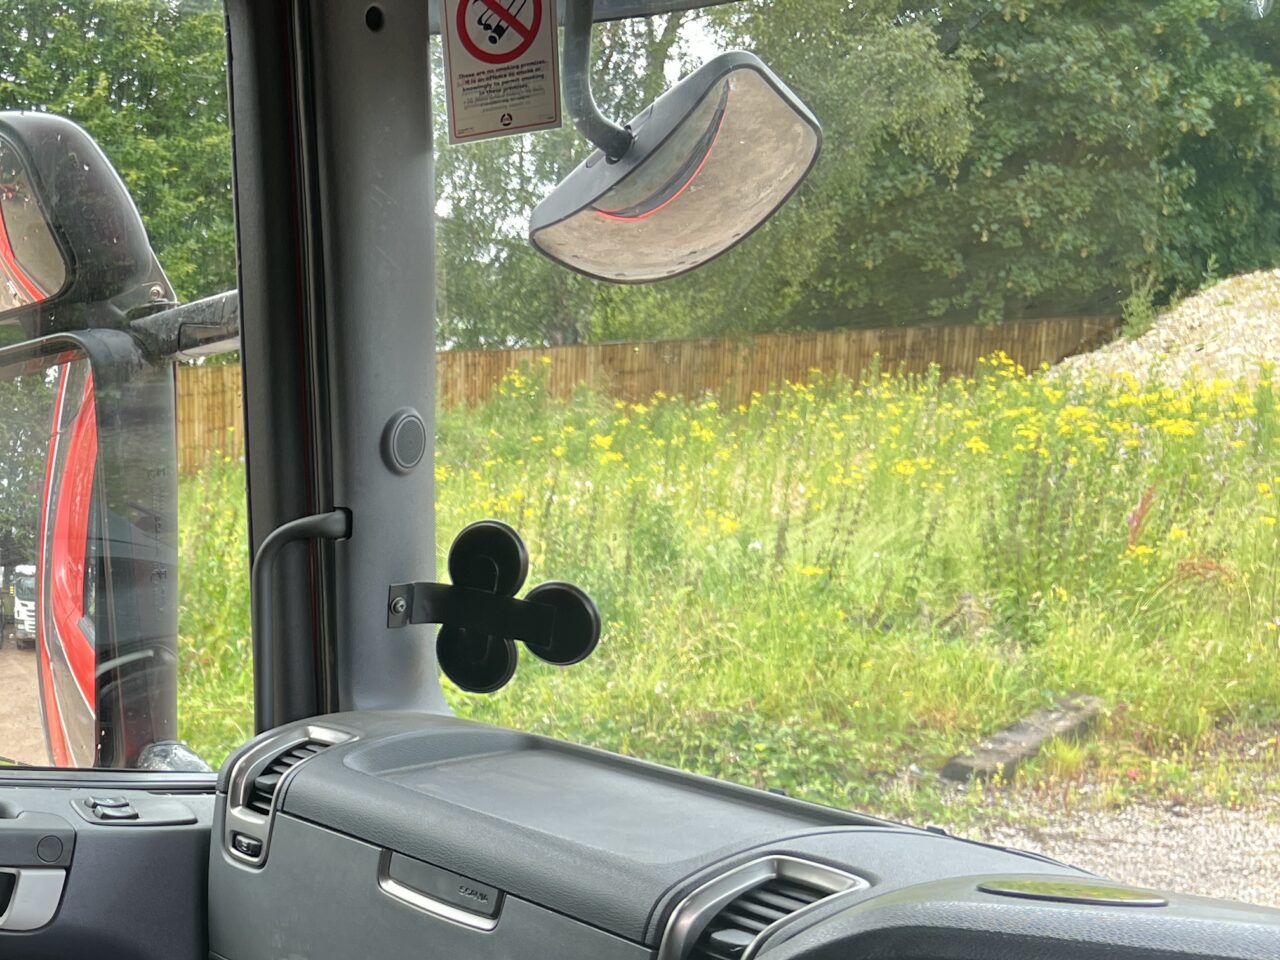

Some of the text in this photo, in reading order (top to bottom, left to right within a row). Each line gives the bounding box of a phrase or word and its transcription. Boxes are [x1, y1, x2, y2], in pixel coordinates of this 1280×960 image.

[496, 65, 519, 74] smoking
[486, 74, 507, 82] offence
[462, 83, 493, 92] knowingly
[501, 78, 520, 87] permit
[521, 74, 544, 83] smoking
